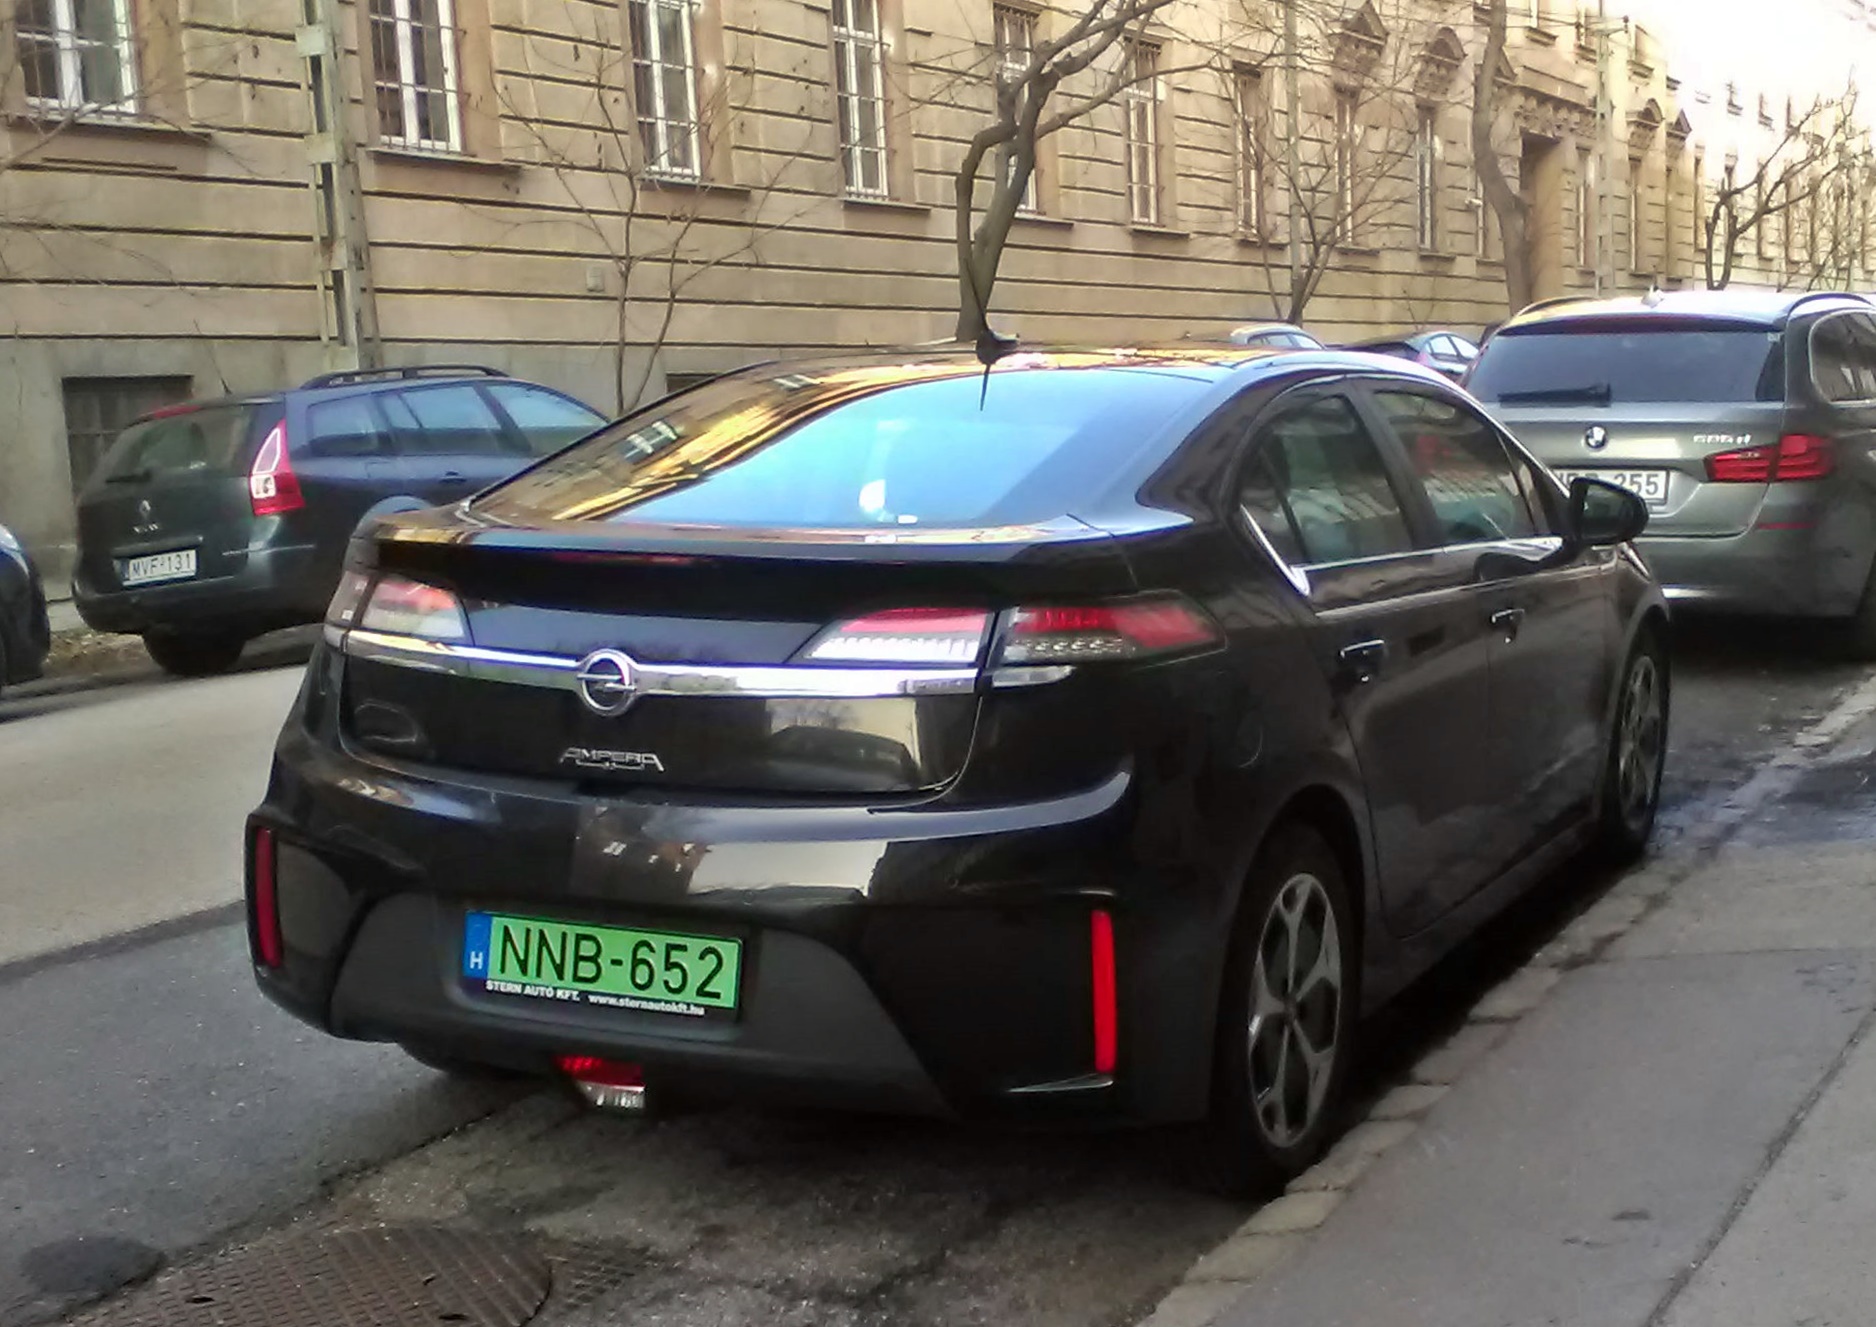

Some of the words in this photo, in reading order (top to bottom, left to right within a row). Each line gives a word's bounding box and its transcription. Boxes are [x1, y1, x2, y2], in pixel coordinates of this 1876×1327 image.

[132, 553, 191, 577] MVF-131
[560, 747, 664, 771] AMPERA
[469, 951, 483, 970] H
[499, 924, 724, 1000] NNB-652
[486, 980, 522, 993] STERN
[523, 985, 554, 998] AUTO
[556, 989, 581, 1001] KFT.
[587, 994, 706, 1016] www.sternautokft.hu
